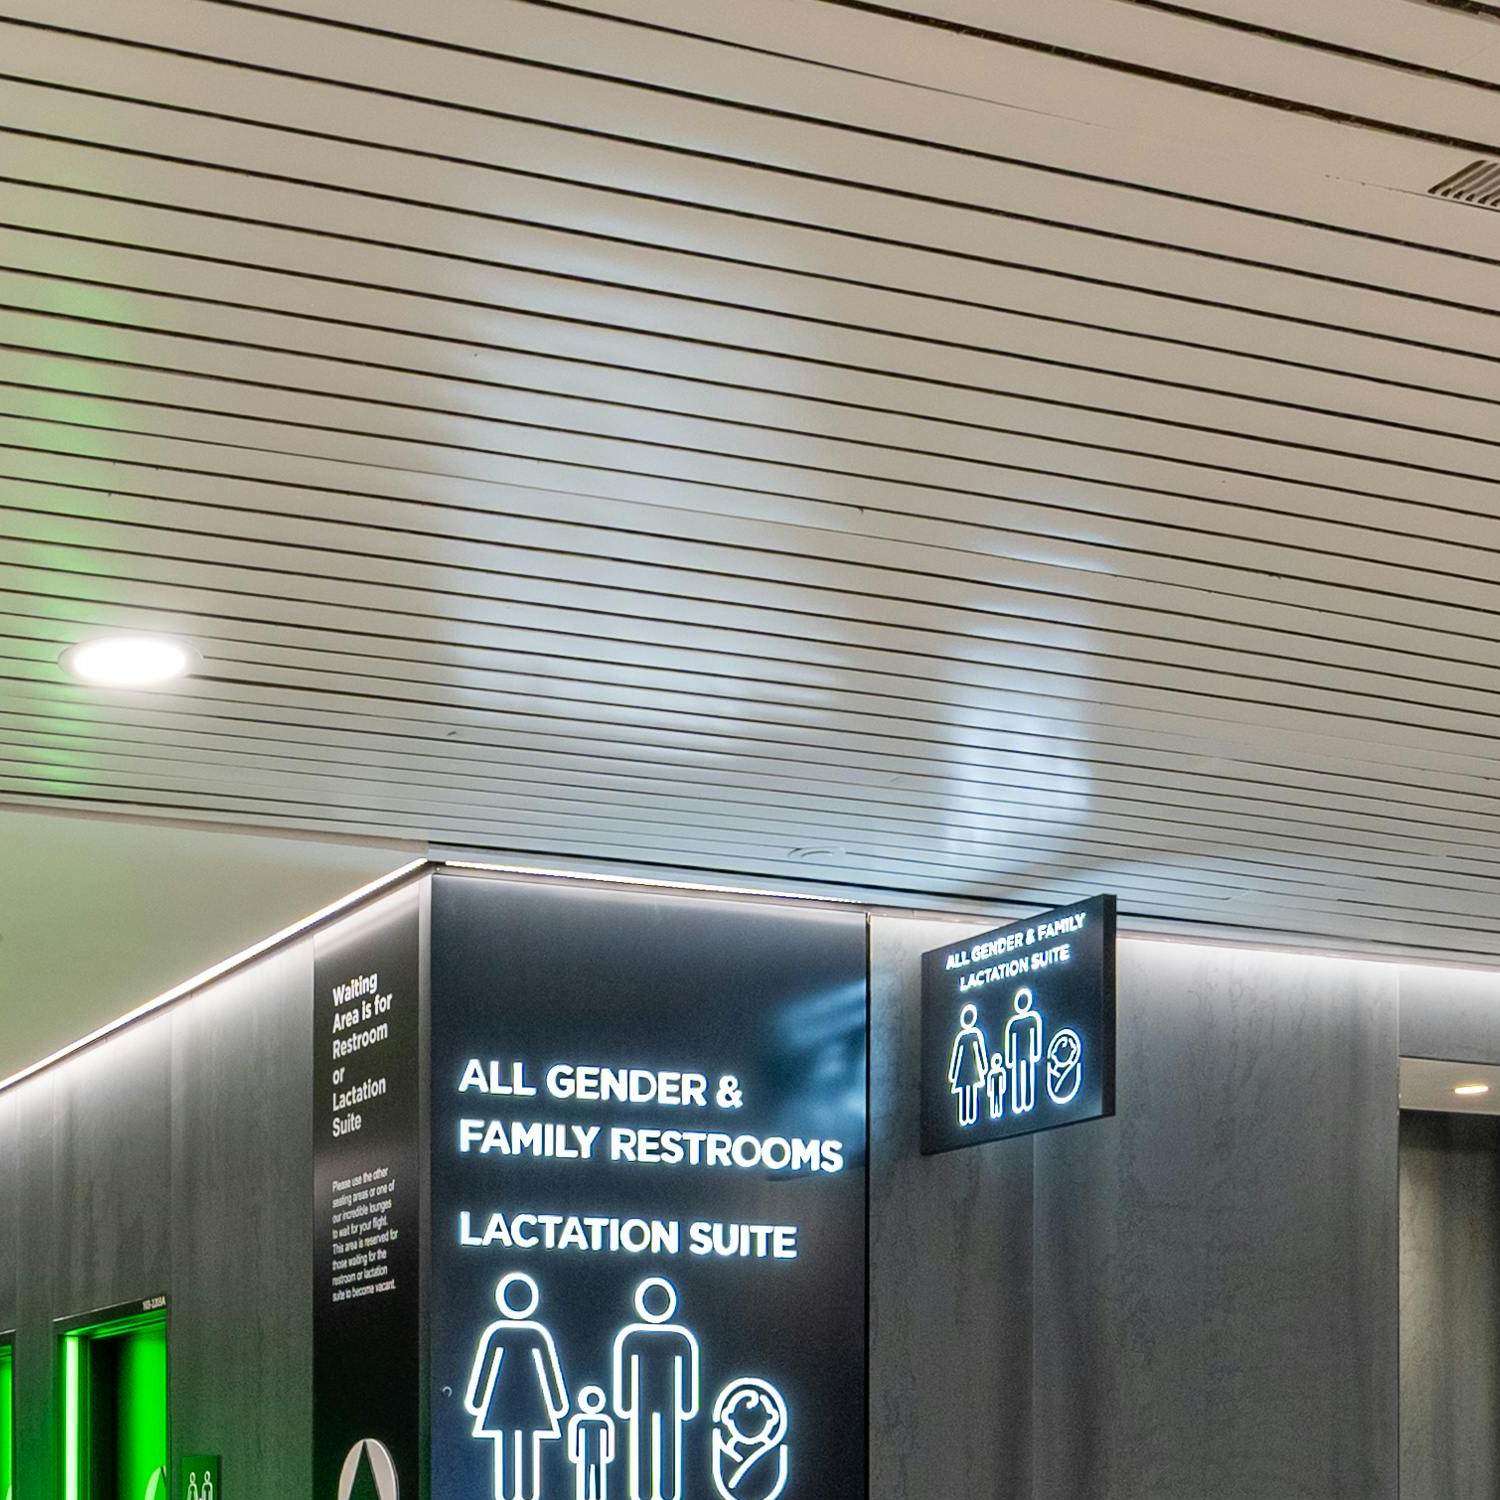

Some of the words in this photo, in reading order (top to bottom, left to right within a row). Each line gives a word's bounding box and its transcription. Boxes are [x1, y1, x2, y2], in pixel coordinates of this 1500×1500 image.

[946, 950, 971, 970] ALL
[971, 932, 1024, 963] GENDER
[1025, 928, 1036, 946] &
[1037, 912, 1087, 941] FAMILY
[959, 956, 1029, 992] LACTATION
[1030, 943, 1071, 970] SUITE
[332, 972, 378, 1007] Waiting
[332, 1013, 359, 1034] Area
[362, 1000, 371, 1021] is
[374, 993, 393, 1016] for
[332, 1022, 388, 1060] Restroom
[332, 1066, 346, 1085] or
[332, 1077, 387, 1112] Lactation
[457, 1058, 538, 1097] ALL
[546, 1063, 708, 1107] GENDER
[716, 1074, 744, 1109] &
[332, 1113, 362, 1137] Suite
[458, 1118, 601, 1160] FAMILY
[610, 1126, 845, 1174] RESTROOMS
[332, 1179, 351, 1192] Please
[373, 1167, 388, 1180] other
[342, 1204, 369, 1220] incredible
[369, 1199, 392, 1213] lounges
[458, 1210, 679, 1254] LACTATION
[689, 1221, 799, 1259] SUITE
